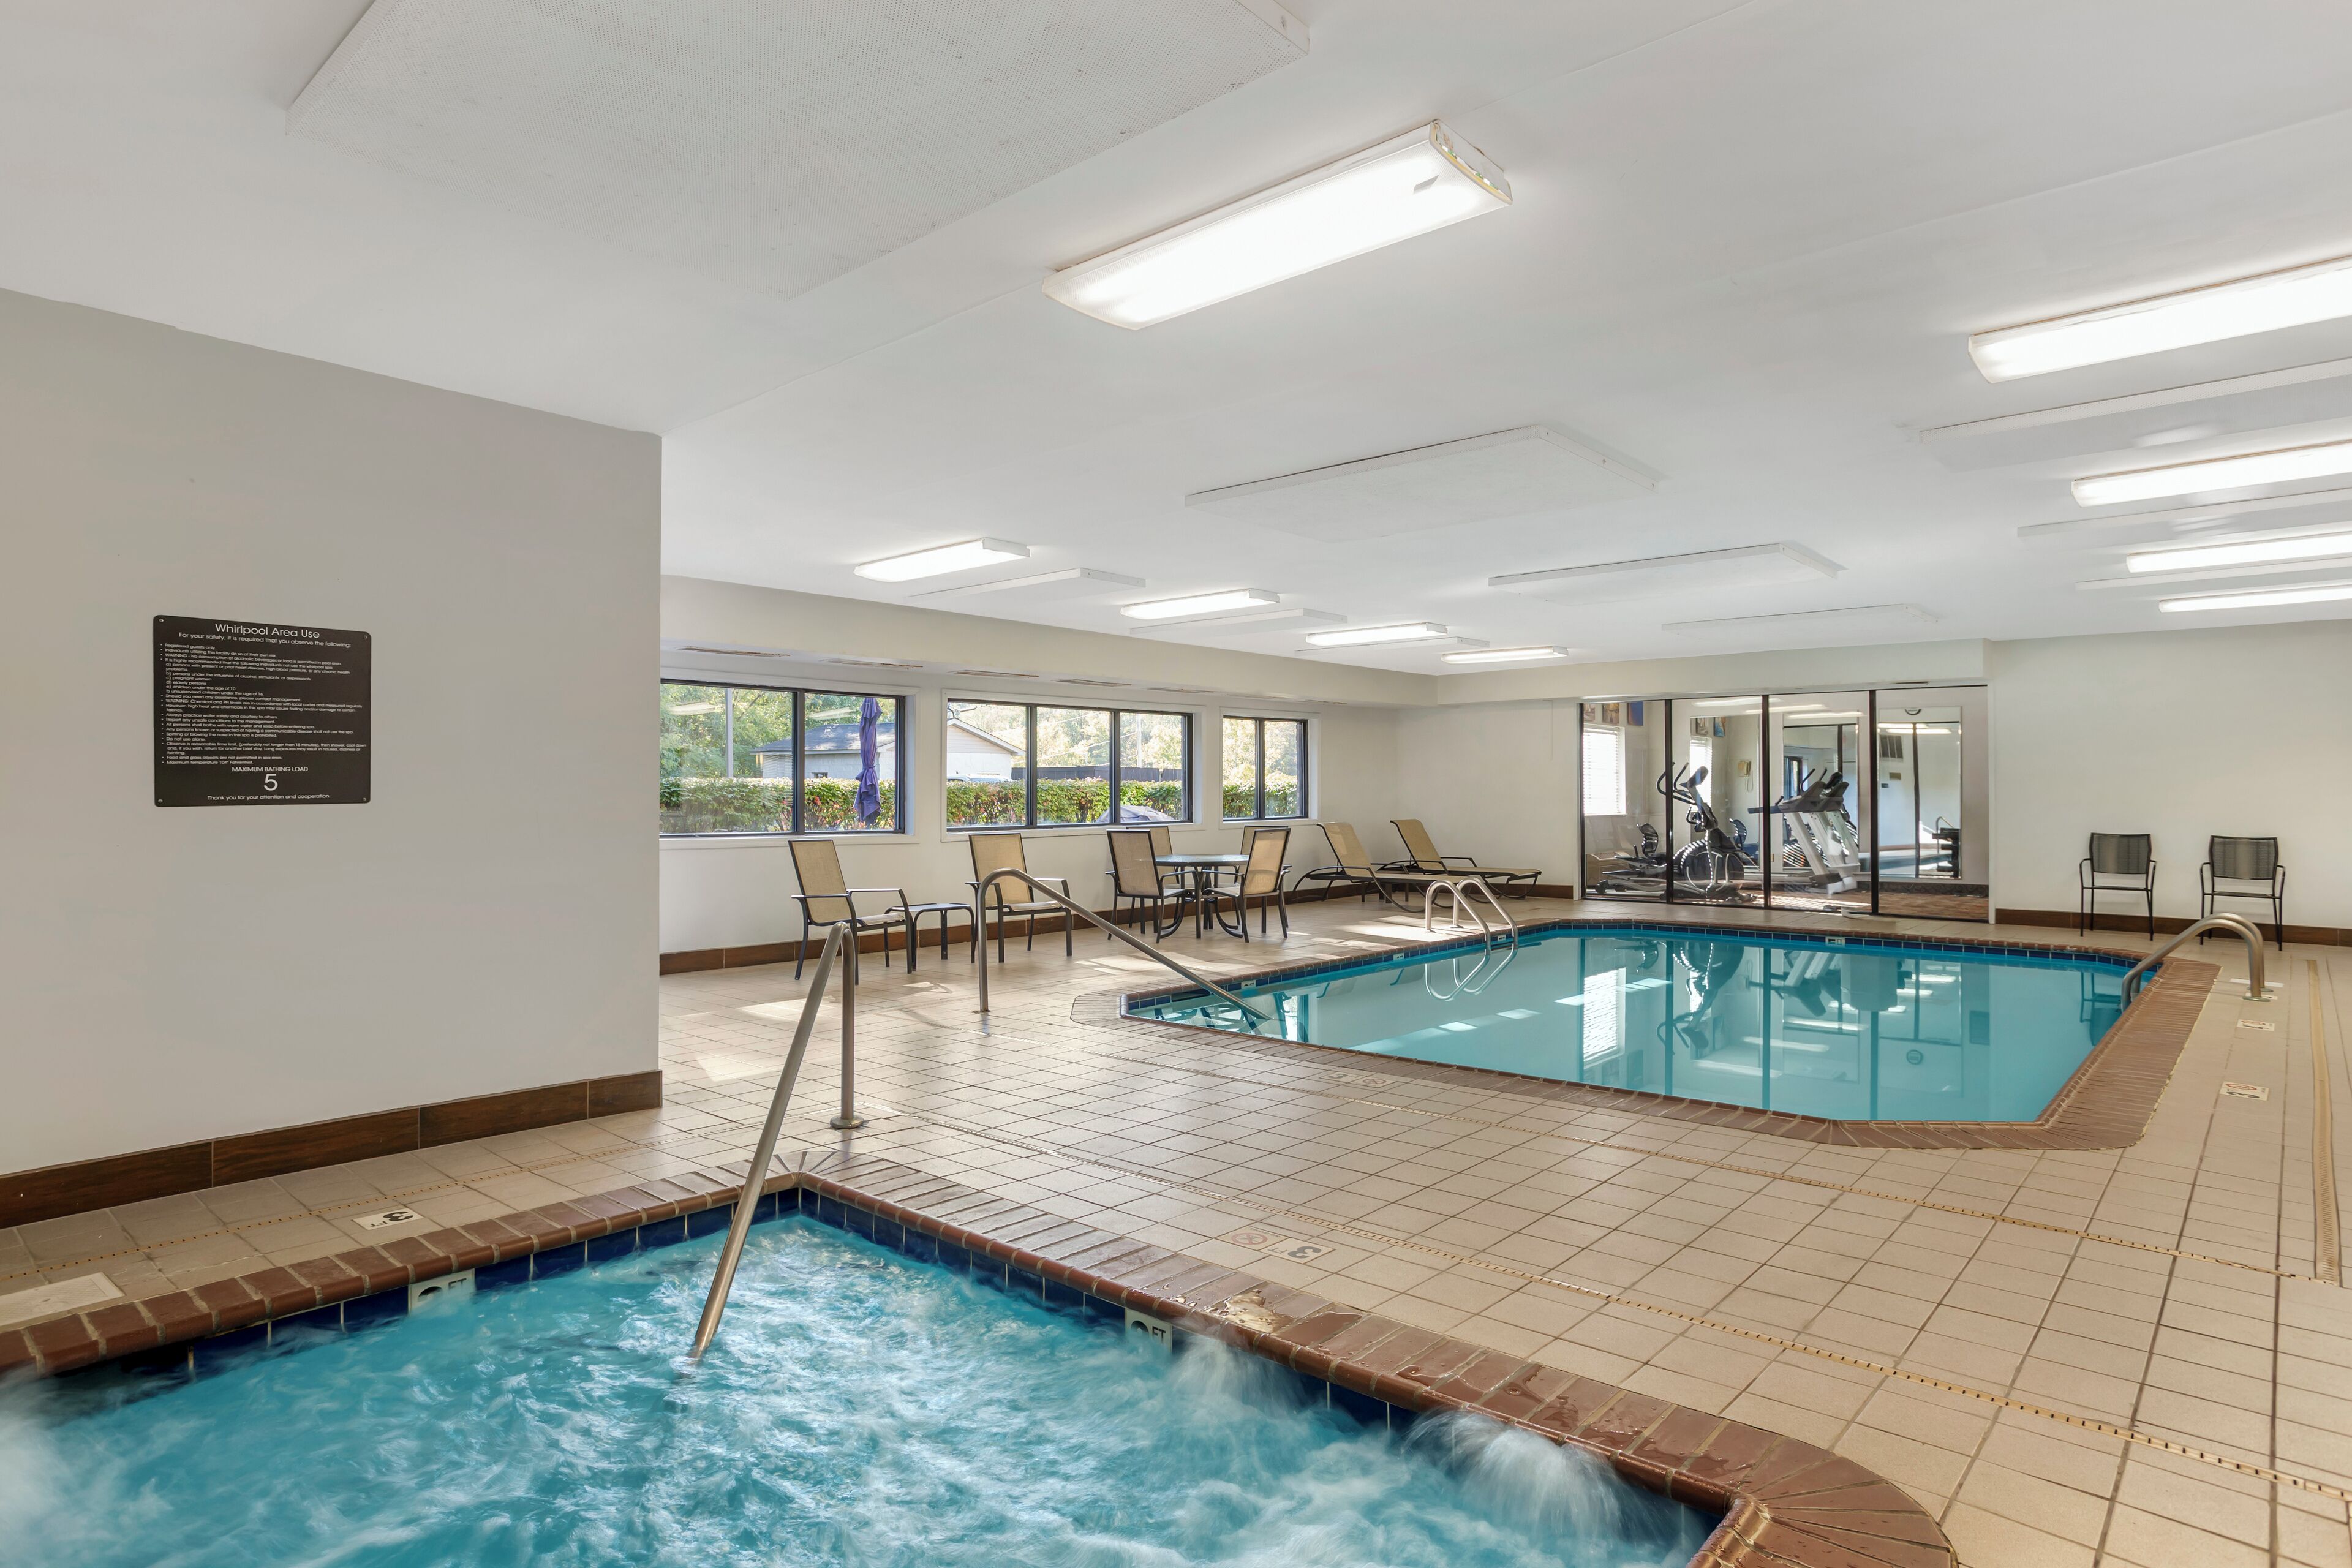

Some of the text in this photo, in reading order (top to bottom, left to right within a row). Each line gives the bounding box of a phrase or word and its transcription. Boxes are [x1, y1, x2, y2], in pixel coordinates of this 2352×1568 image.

[215, 624, 320, 638] Whirlpool Area Use
[264, 774, 277, 790] 5
[383, 1211, 413, 1221] 3
[1287, 1246, 1322, 1259] 3
[1152, 1326, 1166, 1342] FT
